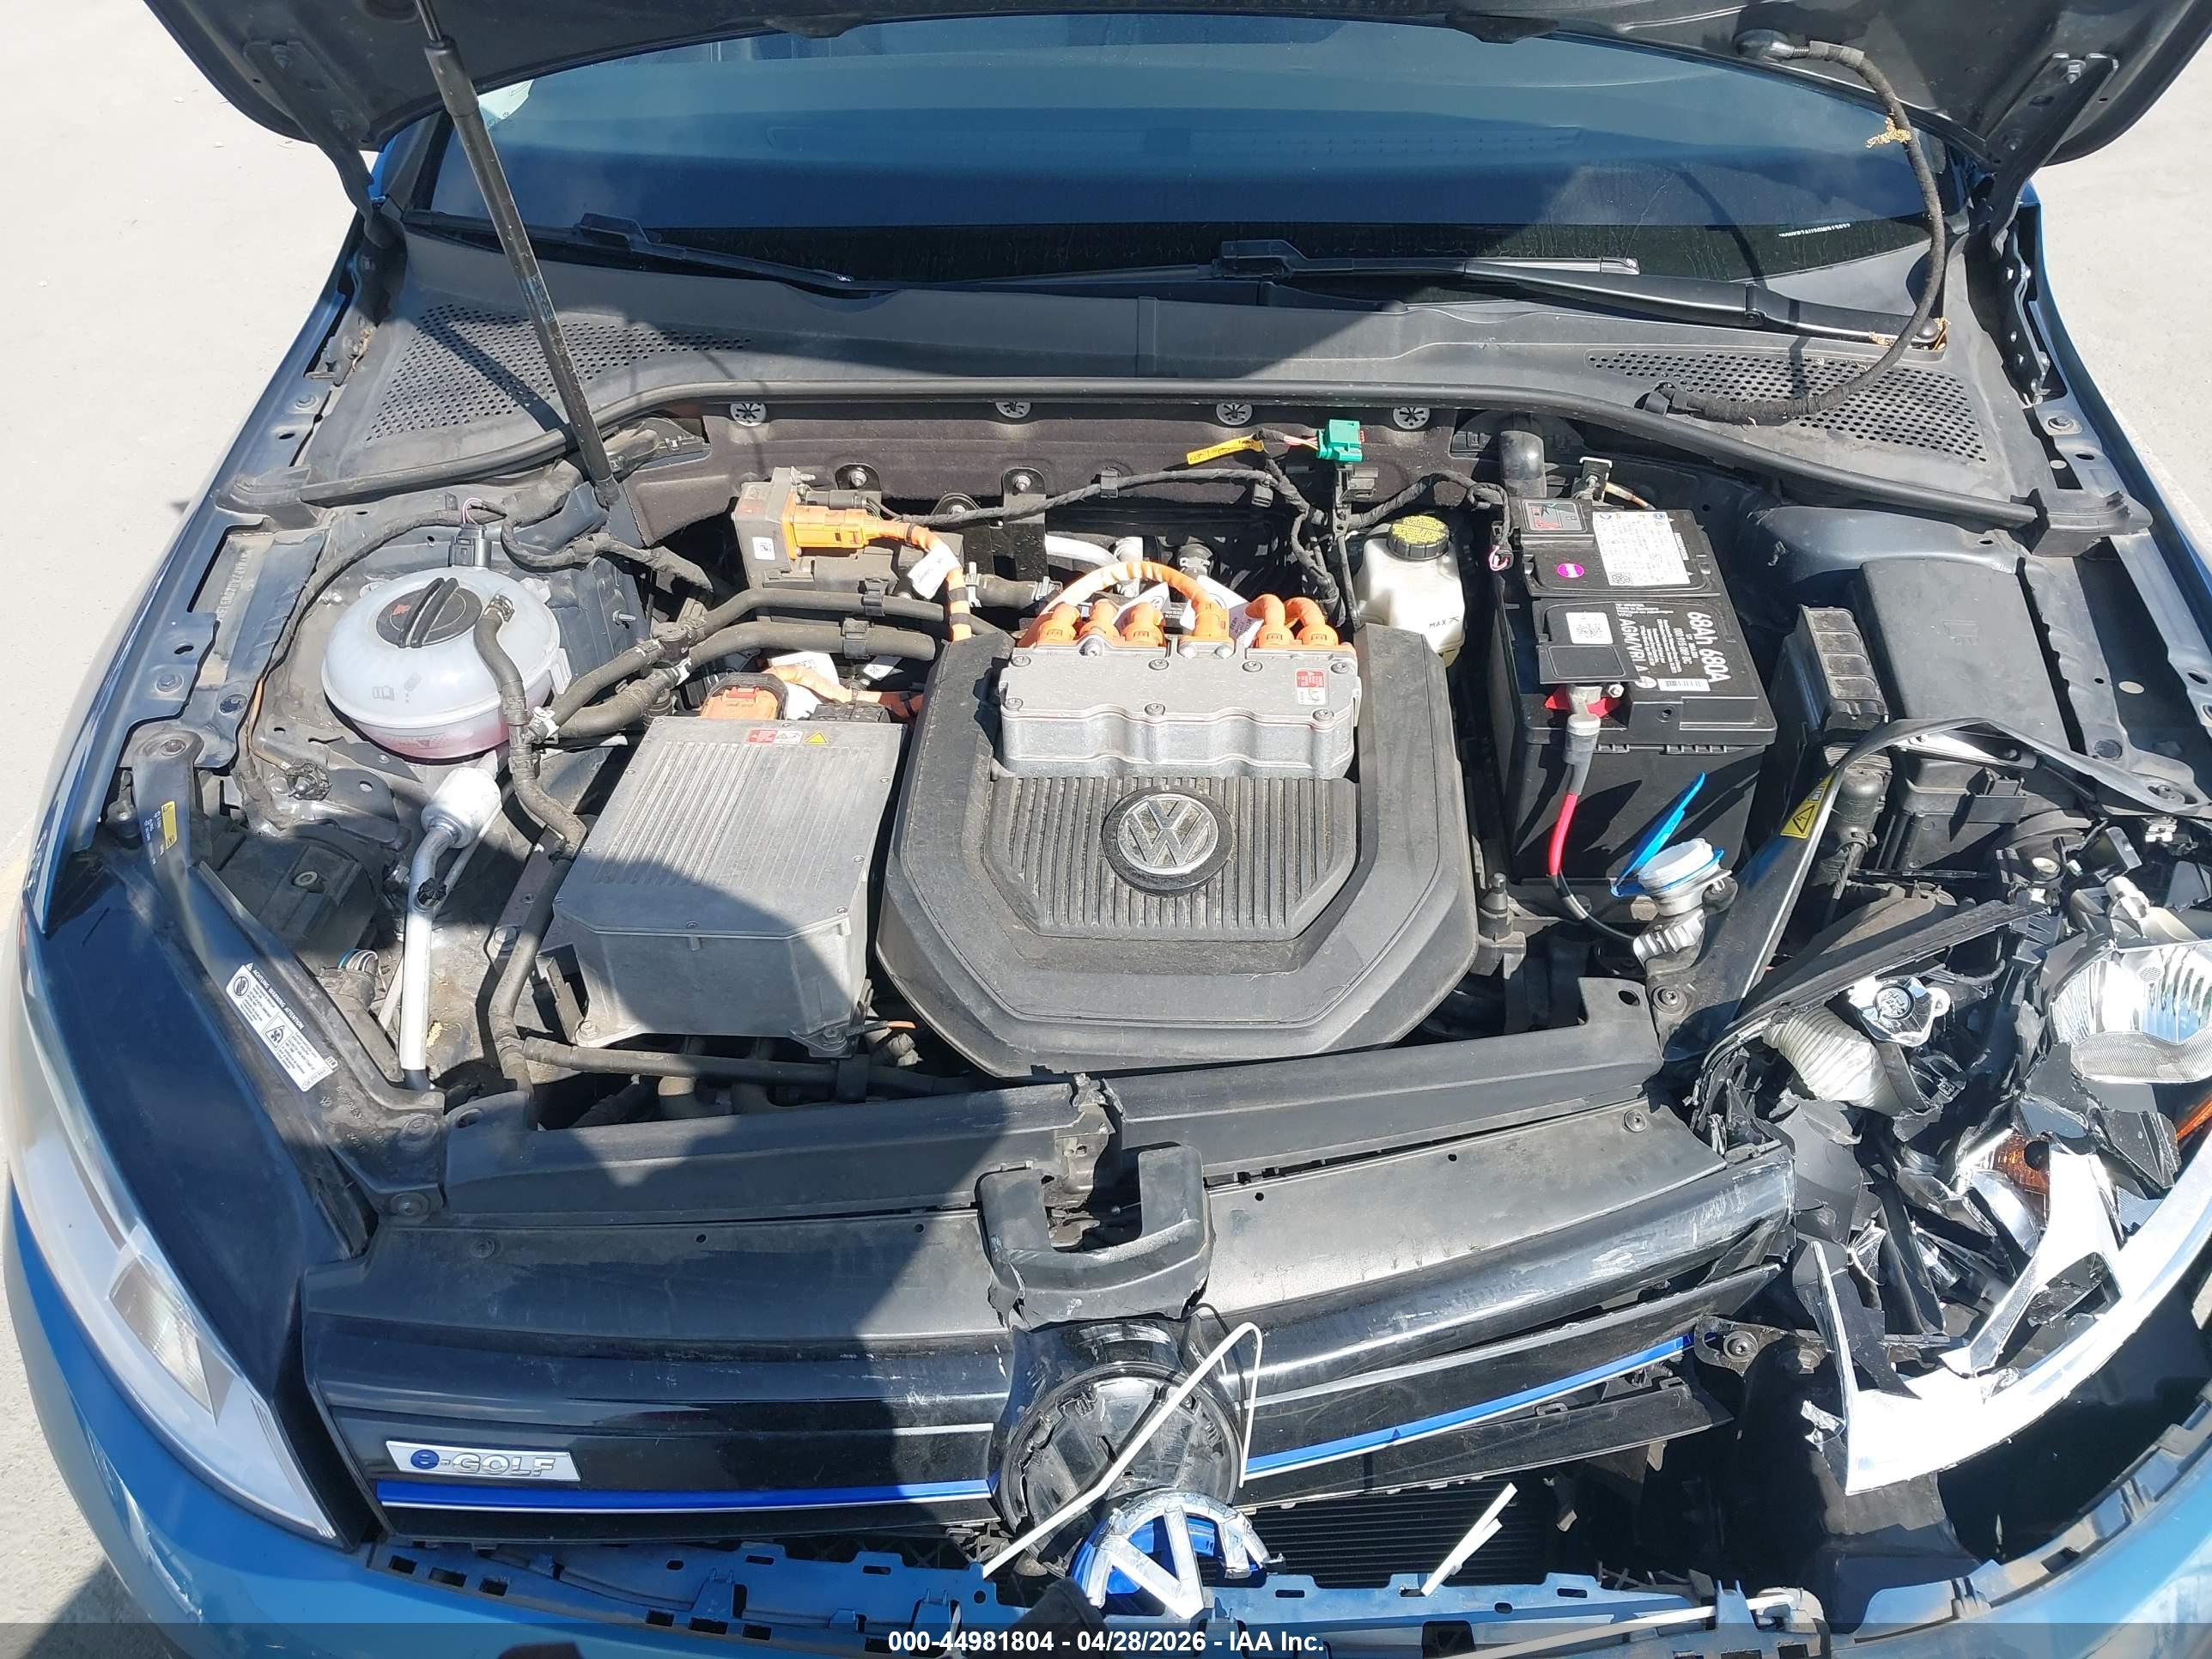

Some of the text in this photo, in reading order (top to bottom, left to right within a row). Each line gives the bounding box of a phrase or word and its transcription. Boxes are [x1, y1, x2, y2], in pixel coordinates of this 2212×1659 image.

[1429, 619, 1446, 629] MAX
[1687, 611, 1731, 683] 68Ah 680A
[252, 969, 270, 989] ACHTUNG
[268, 988, 286, 1008] WARNING
[284, 1007, 305, 1030] ATTENTION
[410, 1449, 556, 1477] e-GOLF
